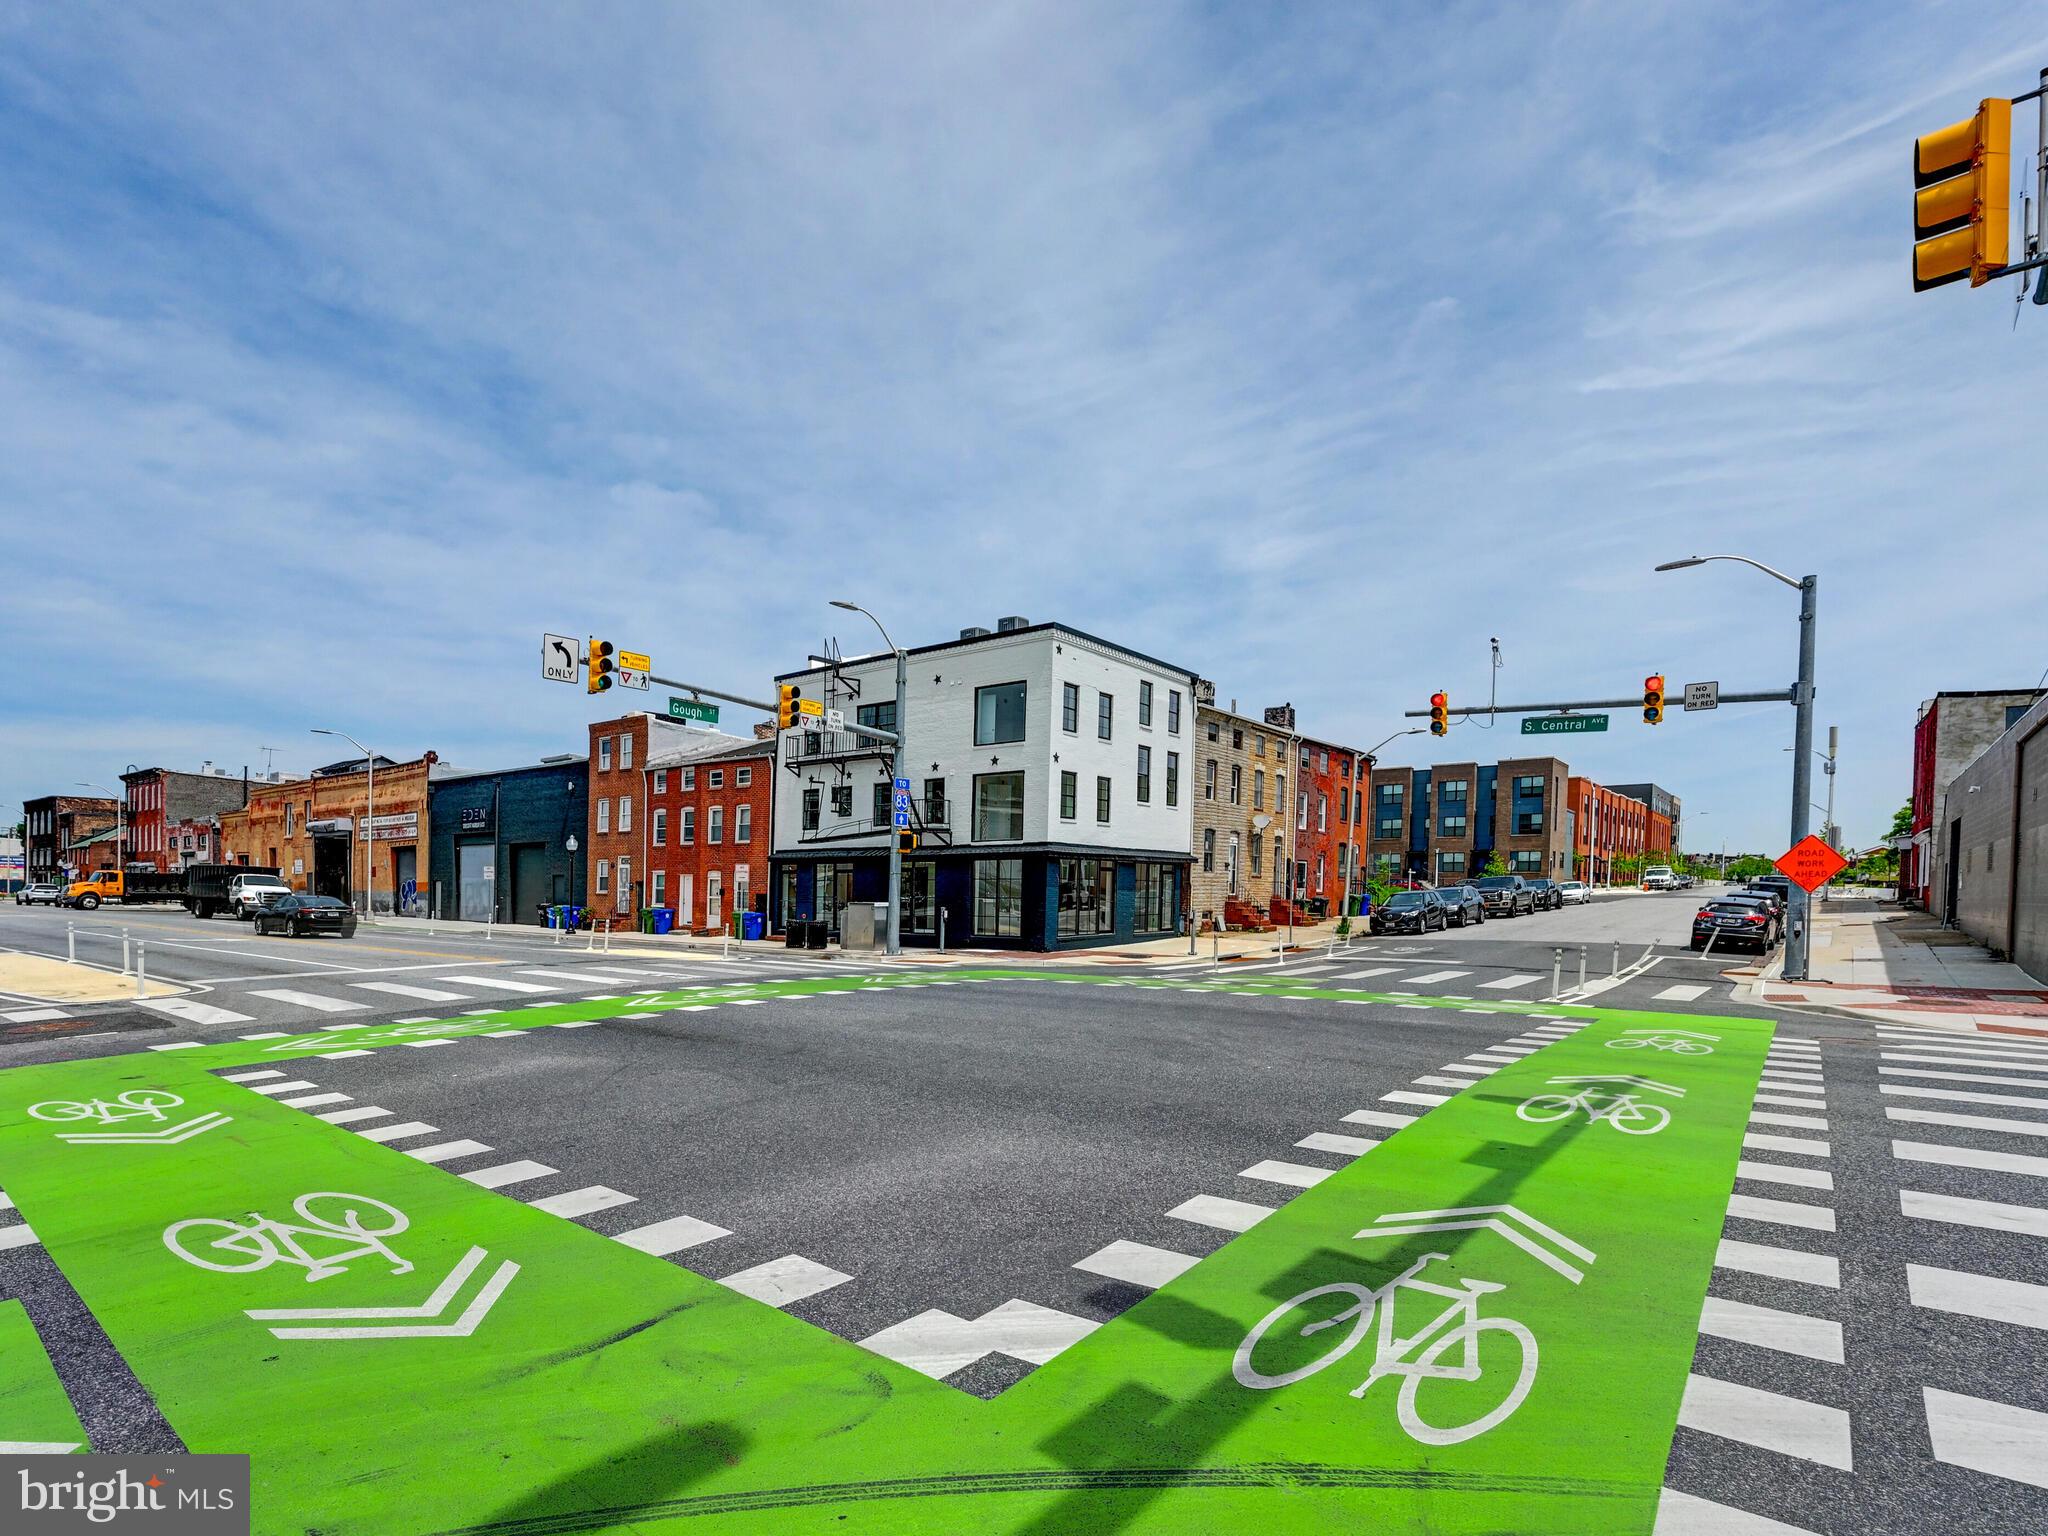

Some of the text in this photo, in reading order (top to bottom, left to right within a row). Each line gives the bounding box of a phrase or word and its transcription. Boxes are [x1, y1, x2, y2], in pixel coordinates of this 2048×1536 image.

[548, 667, 573, 679] ONLY
[672, 703, 702, 719] Gough
[1525, 721, 1535, 731] S.
[1541, 720, 1586, 731] Central
[896, 795, 908, 808] 83
[463, 808, 486, 820] EDEN
